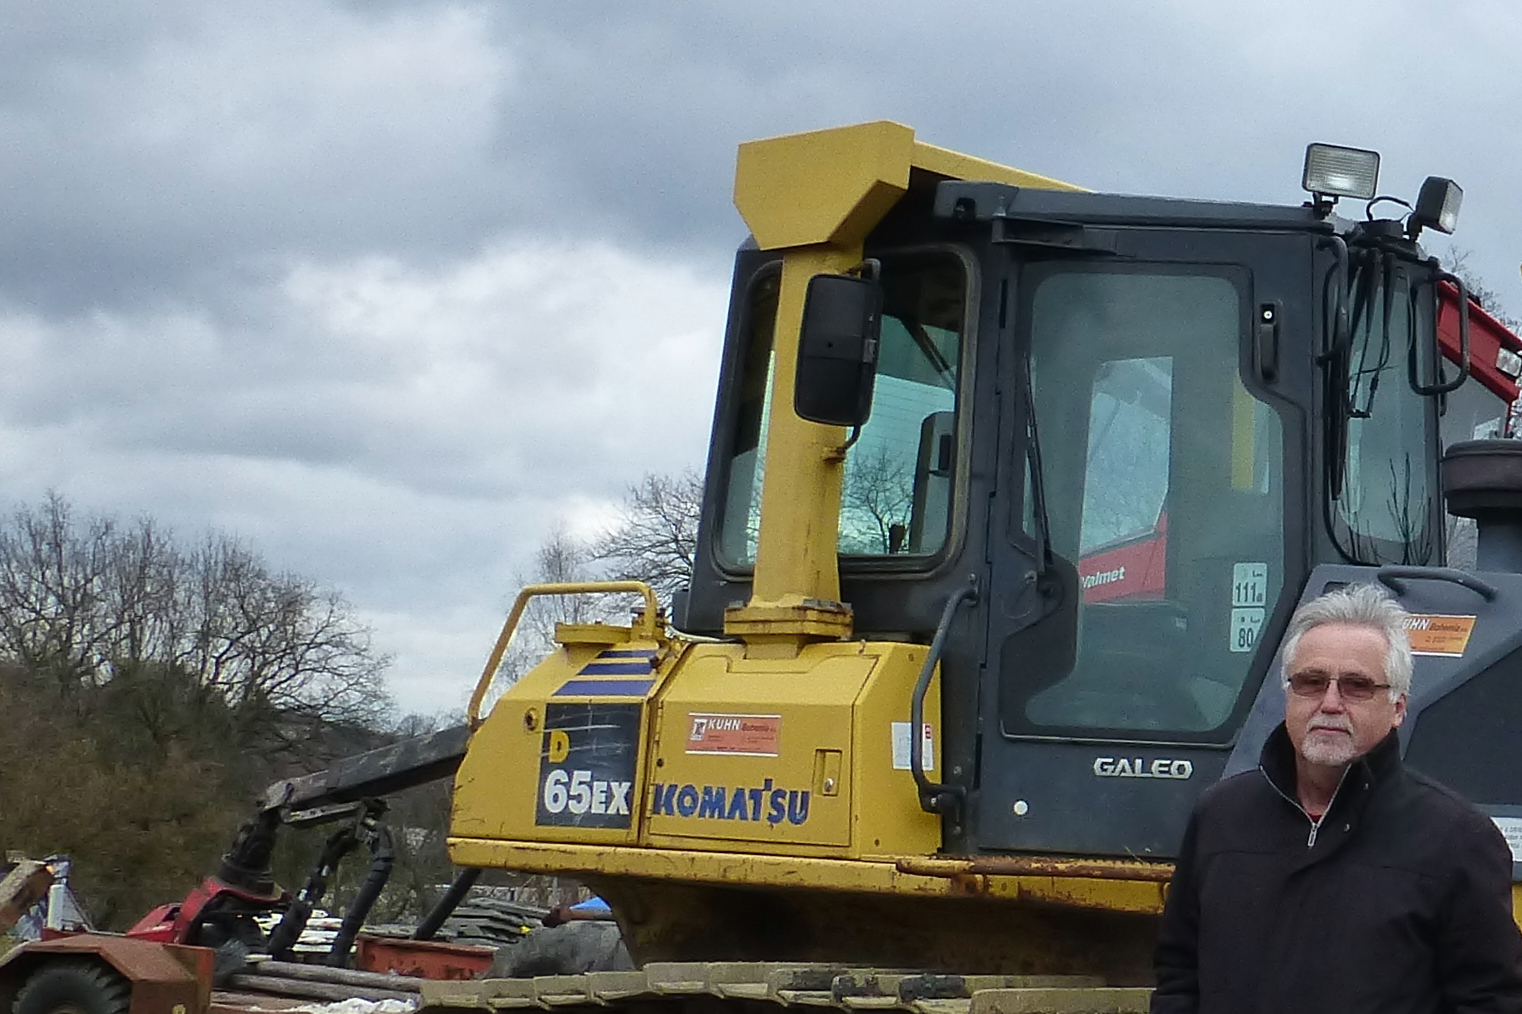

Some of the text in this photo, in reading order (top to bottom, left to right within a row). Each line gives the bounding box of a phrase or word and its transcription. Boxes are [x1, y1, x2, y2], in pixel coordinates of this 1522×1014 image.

[1081, 566, 1126, 588] Valmet
[1402, 618, 1430, 631] UHN
[1238, 627, 1254, 648] 80
[708, 718, 741, 731] KUHN
[548, 729, 570, 763] D
[1093, 757, 1193, 779] GALEO
[544, 769, 632, 815] 65EX
[652, 778, 812, 826] KOMATSU
